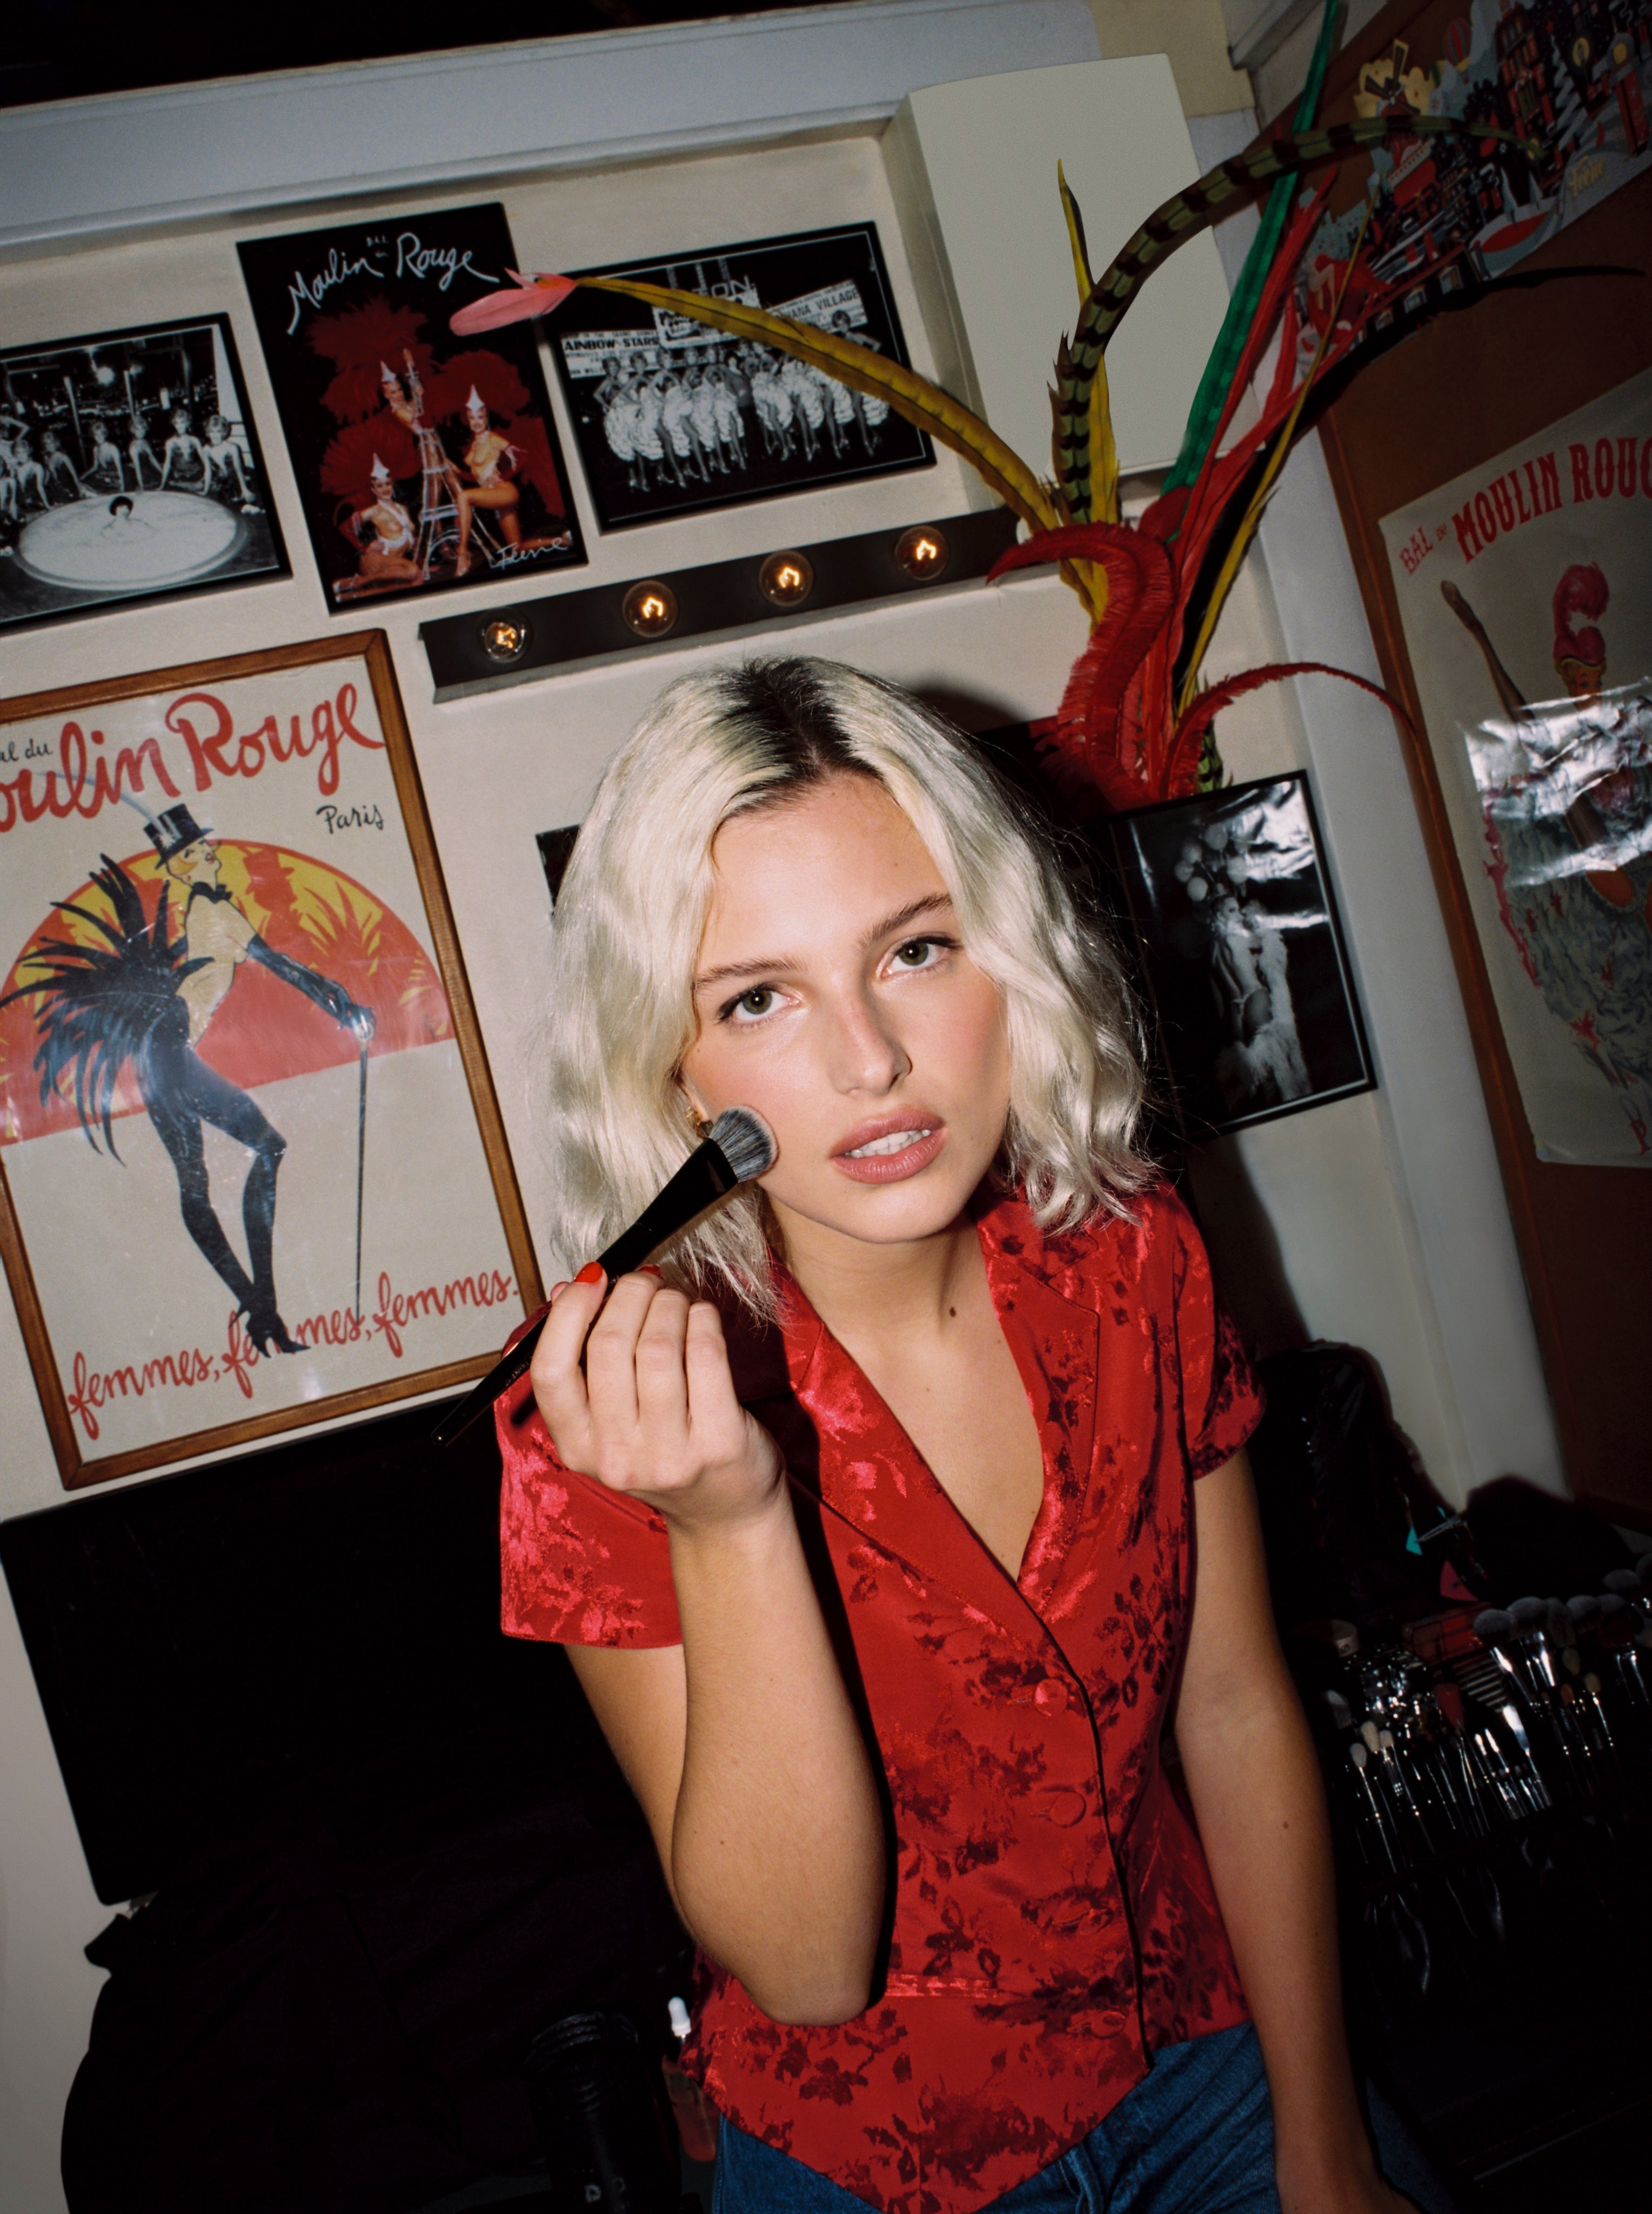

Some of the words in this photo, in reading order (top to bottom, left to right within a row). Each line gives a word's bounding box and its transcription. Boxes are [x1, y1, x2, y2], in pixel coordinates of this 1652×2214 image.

[286, 248, 385, 334] Moulin
[396, 233, 500, 290] Rouge
[815, 288, 859, 310] VILLAGE
[565, 339, 615, 350] AINBOW
[623, 337, 659, 347] STARS
[1399, 526, 1433, 575] BAL
[1452, 452, 1563, 563] MOULIN
[24, 738, 53, 758] du
[165, 683, 385, 796] Rouge
[316, 805, 384, 834] Paris
[68, 1348, 220, 1440] femmes,
[222, 1307, 372, 1399] femes,
[373, 1269, 519, 1357] femmes.
